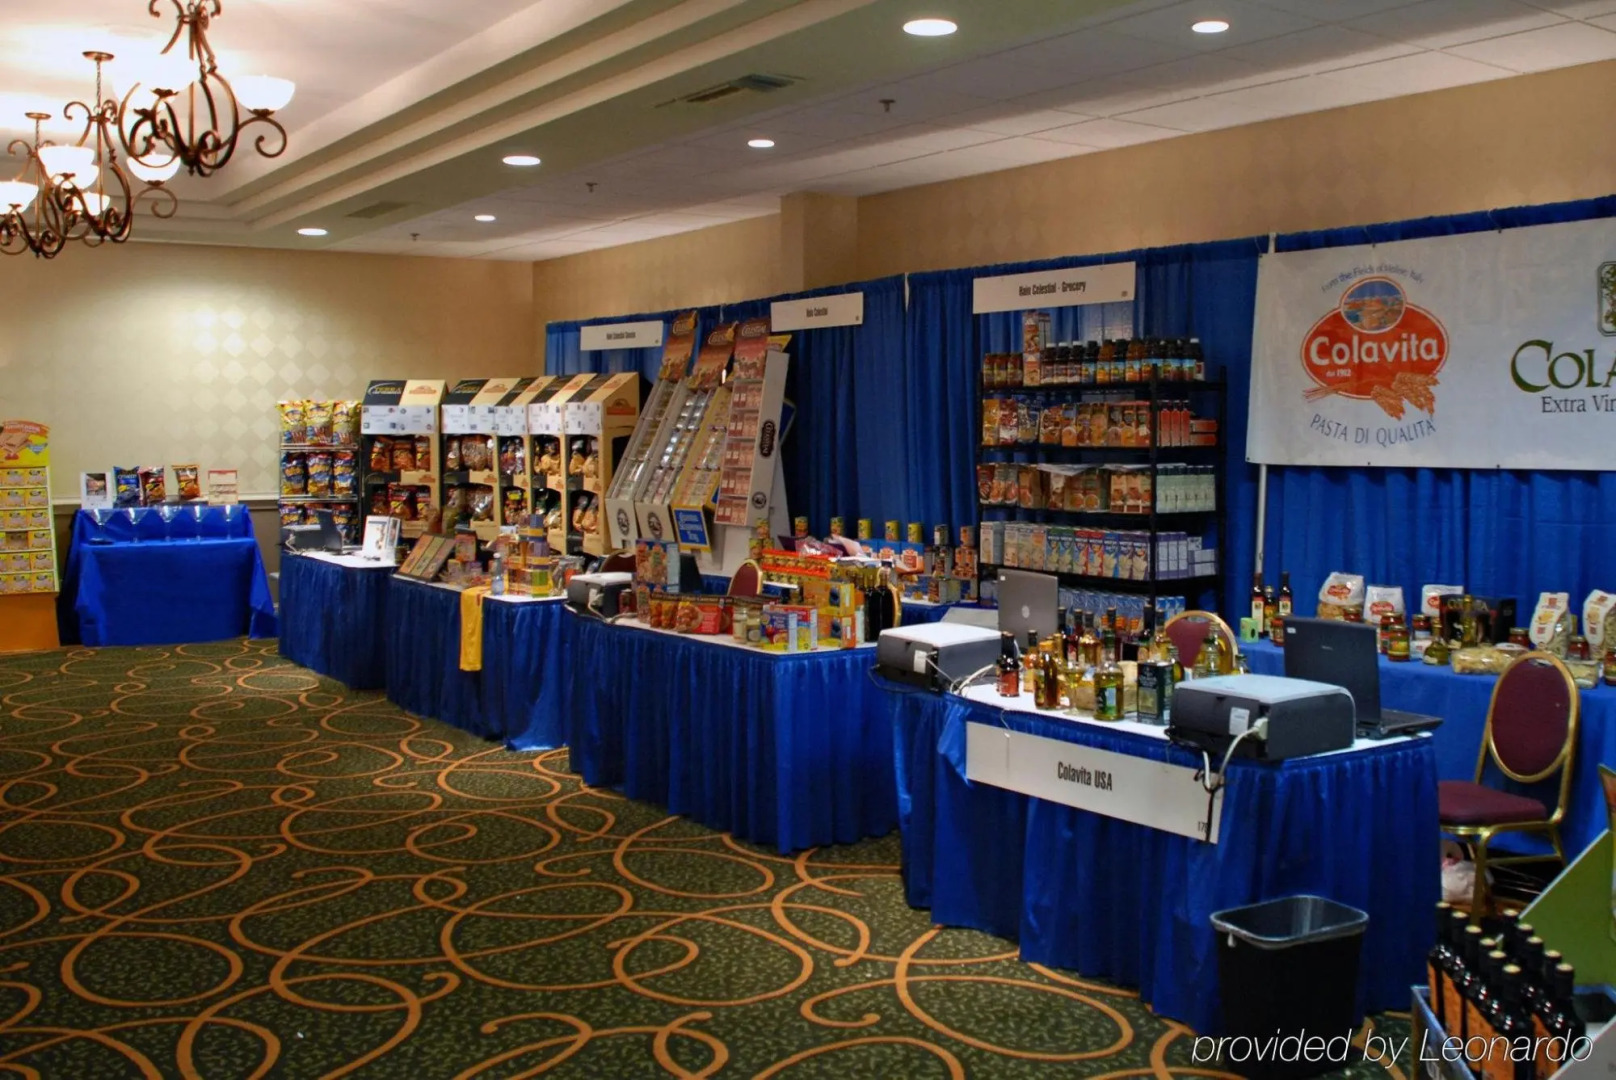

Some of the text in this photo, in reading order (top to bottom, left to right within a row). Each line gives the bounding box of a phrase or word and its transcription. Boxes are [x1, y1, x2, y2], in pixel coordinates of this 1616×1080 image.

[1062, 281, 1086, 293] Grocery
[1309, 333, 1440, 366] Colavita
[1541, 396, 1586, 413] Extra
[1310, 413, 1348, 442] PASTA
[1354, 427, 1369, 444] DI
[1057, 760, 1113, 791] Colavita USA
